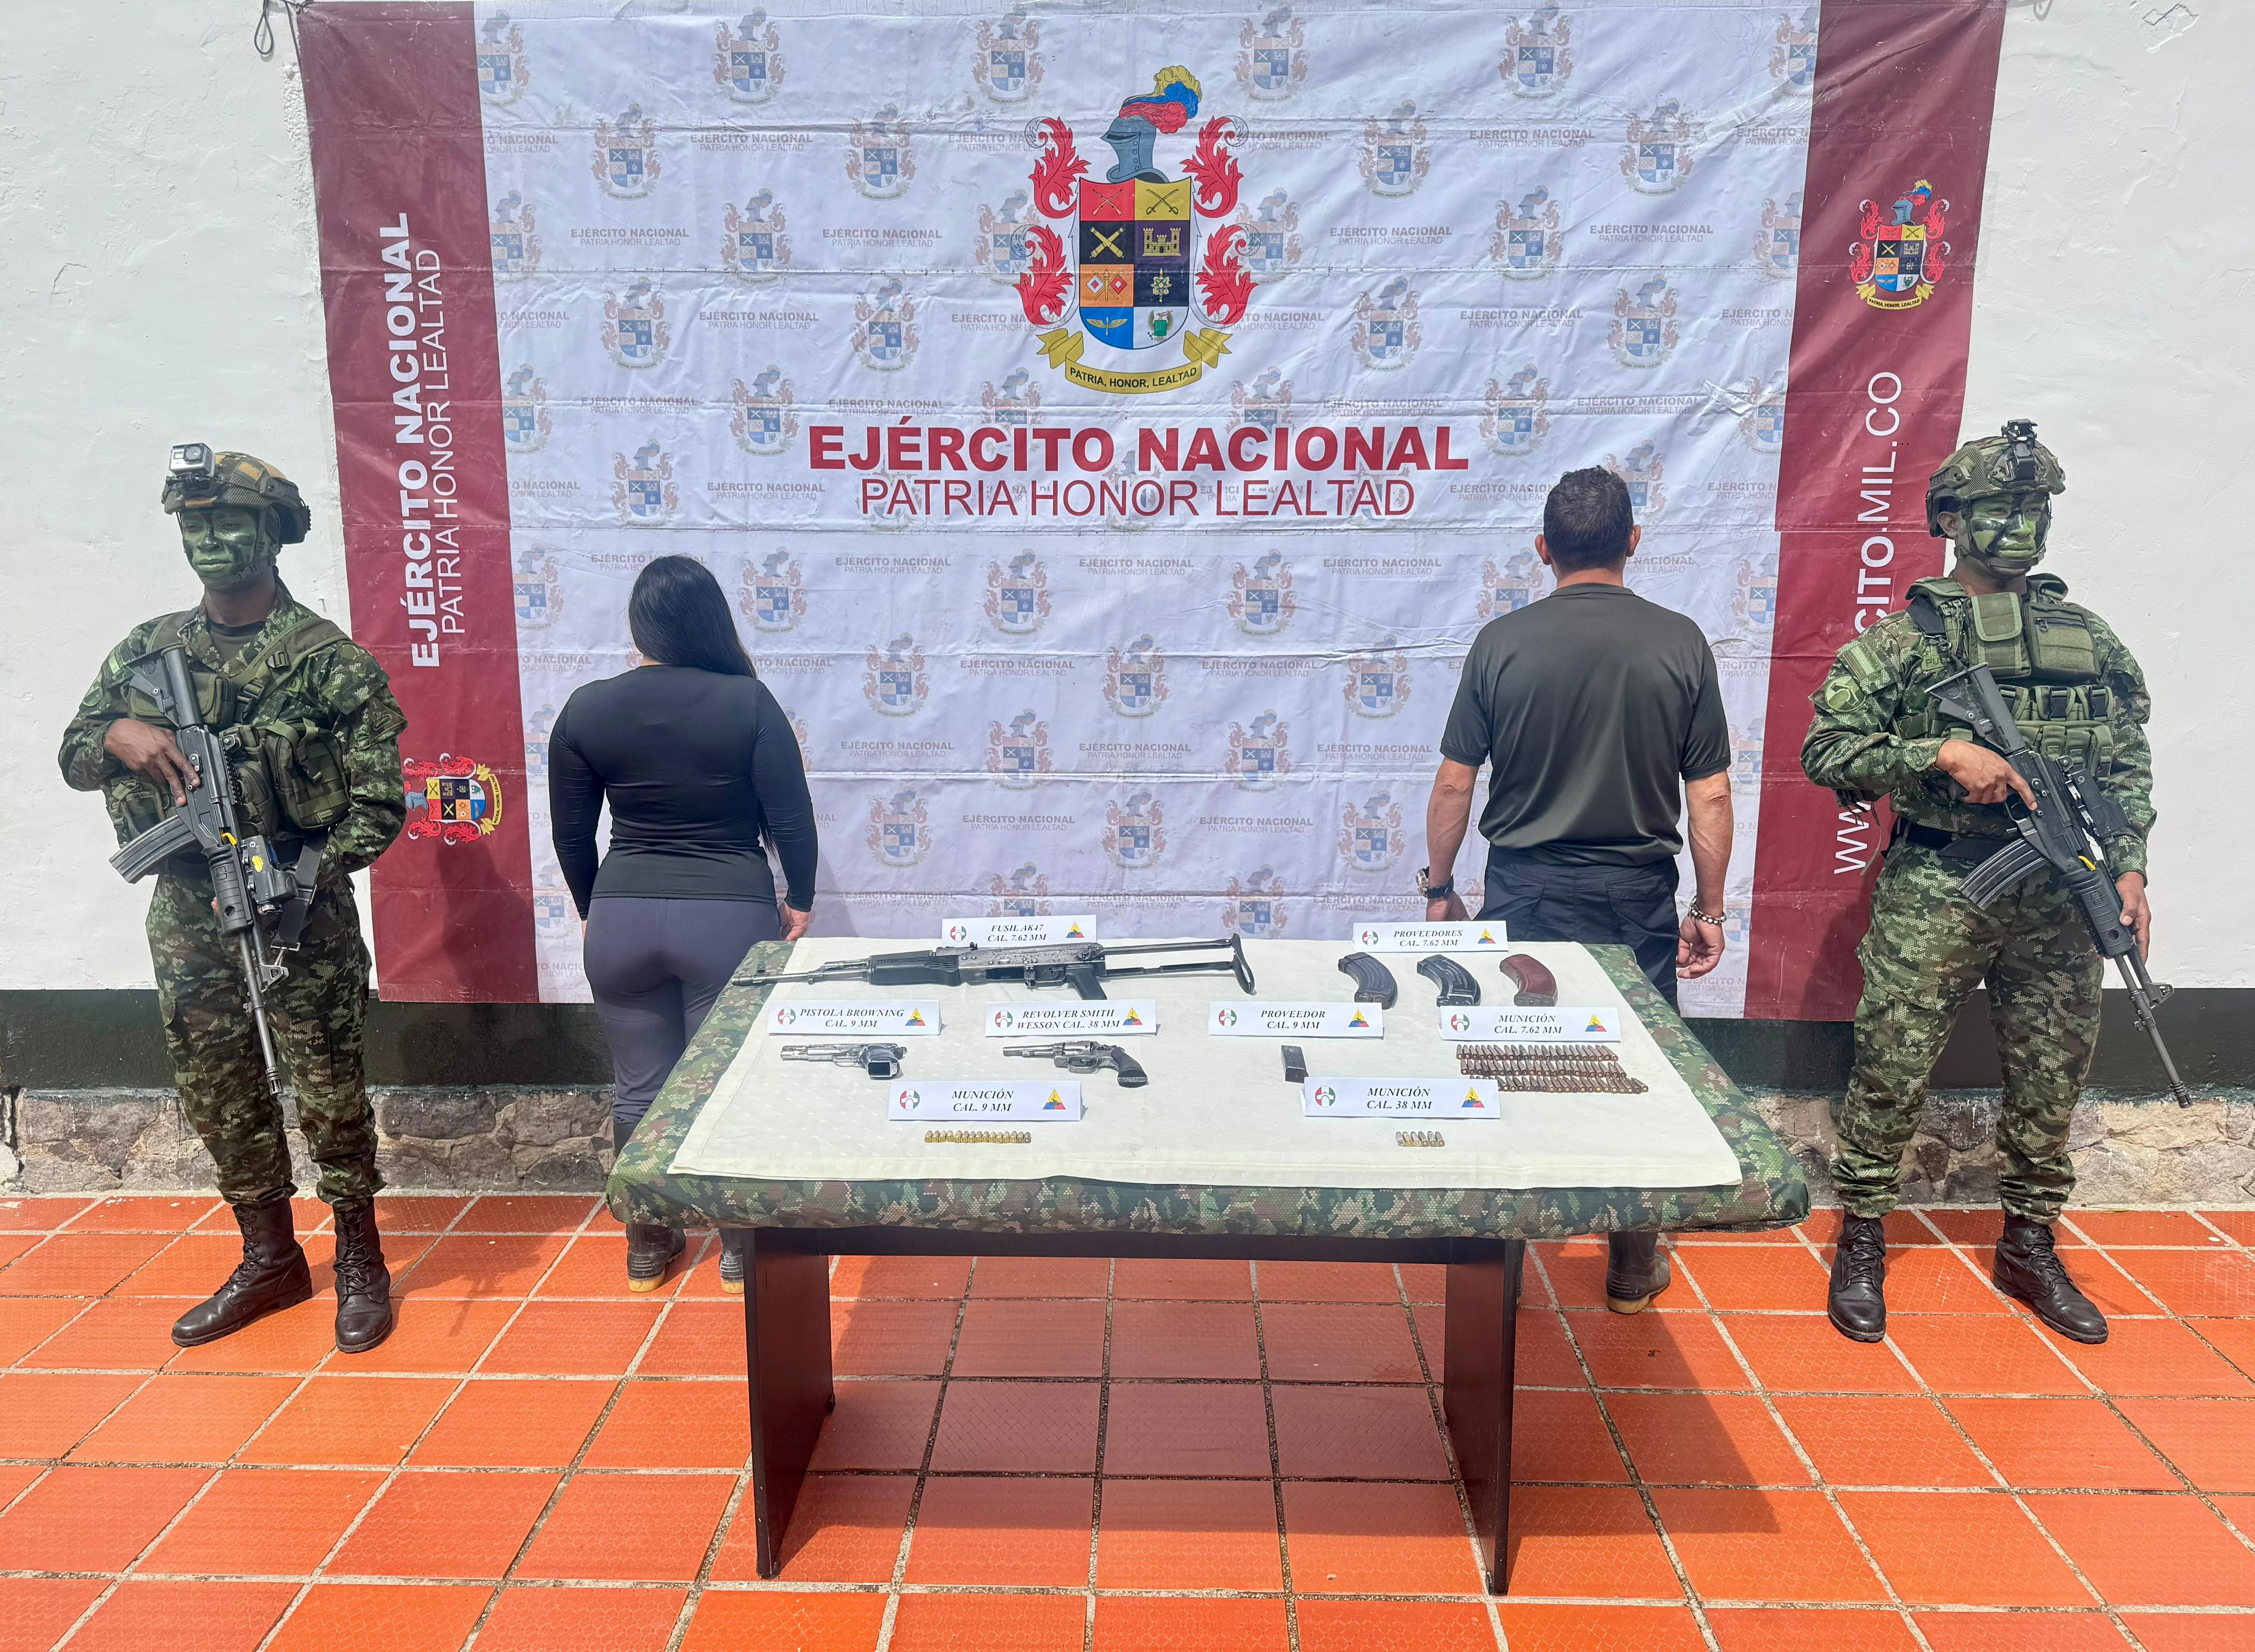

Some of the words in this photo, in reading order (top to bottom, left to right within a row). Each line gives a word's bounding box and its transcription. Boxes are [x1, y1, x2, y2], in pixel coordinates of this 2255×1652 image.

[1470, 130, 1528, 139] EJÉRCITO
[1532, 131, 1595, 139] NACIONAL
[1478, 139, 1509, 147] PATRIA
[1511, 139, 1544, 147] HONOR
[1547, 139, 1585, 147] LEALTAD
[571, 228, 626, 238] EJÉRCITO
[630, 229, 689, 238] NACIONAL
[822, 228, 878, 238] EJÉRCITO
[882, 229, 942, 238] NACIONAL
[1330, 227, 1387, 236] EJÉRCITO
[1391, 228, 1452, 236] NACIONAL
[1590, 223, 1647, 234] EJÉRCITO
[1652, 225, 1713, 234] NACIONAL
[1338, 237, 1368, 245] PATRIA
[1370, 237, 1402, 245] HONOR
[1405, 237, 1442, 245] LEALTAD
[1599, 234, 1628, 242] PATRIA
[1631, 234, 1663, 242] HONOR
[1666, 234, 1703, 242] LEALTAD
[832, 239, 861, 247] PATRIA
[863, 239, 894, 247] HONOR
[897, 239, 933, 247] LEALTAD
[699, 311, 755, 321] EJÉRCITO
[759, 312, 819, 321] NACIONAL
[1460, 309, 1517, 320] EJÉRCITO
[1522, 311, 1583, 320] NACIONAL
[416, 250, 448, 389] LEALTAD
[1469, 319, 1499, 328] PATRIA
[1501, 319, 1533, 328] HONOR
[1536, 319, 1574, 328] LEALTAD
[380, 213, 424, 443] NACIONAL
[709, 321, 738, 330] PATRIA
[740, 321, 771, 330] HONOR
[774, 321, 810, 330] LEALTAD
[1070, 367, 1106, 387] PATRIA,
[1110, 378, 1149, 388] HONOR,
[1152, 367, 1197, 386] LEALTAD
[810, 416, 1113, 471] EJÉRCITO
[1139, 427, 1468, 471] NACIONAL
[427, 401, 458, 518] HONOR
[707, 481, 762, 492] EJÉRCITO
[766, 483, 825, 492] NACIONAL
[863, 480, 1016, 514] PATRIA
[1032, 481, 1196, 515] HONOR
[1217, 480, 1413, 515] LEALTAD
[399, 460, 439, 666] EJÉRCITO
[835, 557, 889, 566] EJÉRCITO
[893, 558, 951, 566] NACIONAL
[1079, 558, 1132, 568] EJÉRCITO
[1136, 559, 1194, 568] NACIONAL
[1323, 558, 1378, 567] EJÉRCITO
[1382, 559, 1441, 567] NACIONAL
[435, 527, 465, 633] PATRIA
[961, 660, 1014, 669] EJÉRCITO
[1202, 661, 1255, 670] EJÉRCITO
[1260, 662, 1317, 670] NACIONAL
[841, 741, 893, 750] EJÉRCITO
[1079, 742, 1131, 751] EJÉRCITO
[1317, 743, 1371, 752] EJÉRCITO
[963, 814, 1015, 823] EJÉRCITO
[1200, 816, 1252, 825] EJÉRCITO
[1023, 1010, 1078, 1018] REVOLVER
[1080, 1009, 1114, 1017] SMITH
[1499, 1013, 1556, 1022] MUNICIÓN
[952, 1088, 1014, 1099] MUNICIÓN
[1368, 1086, 1431, 1097] MUNICIÓN
[953, 1103, 977, 1112] CAL.
[982, 1103, 988, 1112] 9
[990, 1103, 1012, 1112] MM
[1367, 1100, 1391, 1109] CAL.
[1395, 1101, 1408, 1109] 38
[1411, 1101, 1432, 1109] MM
